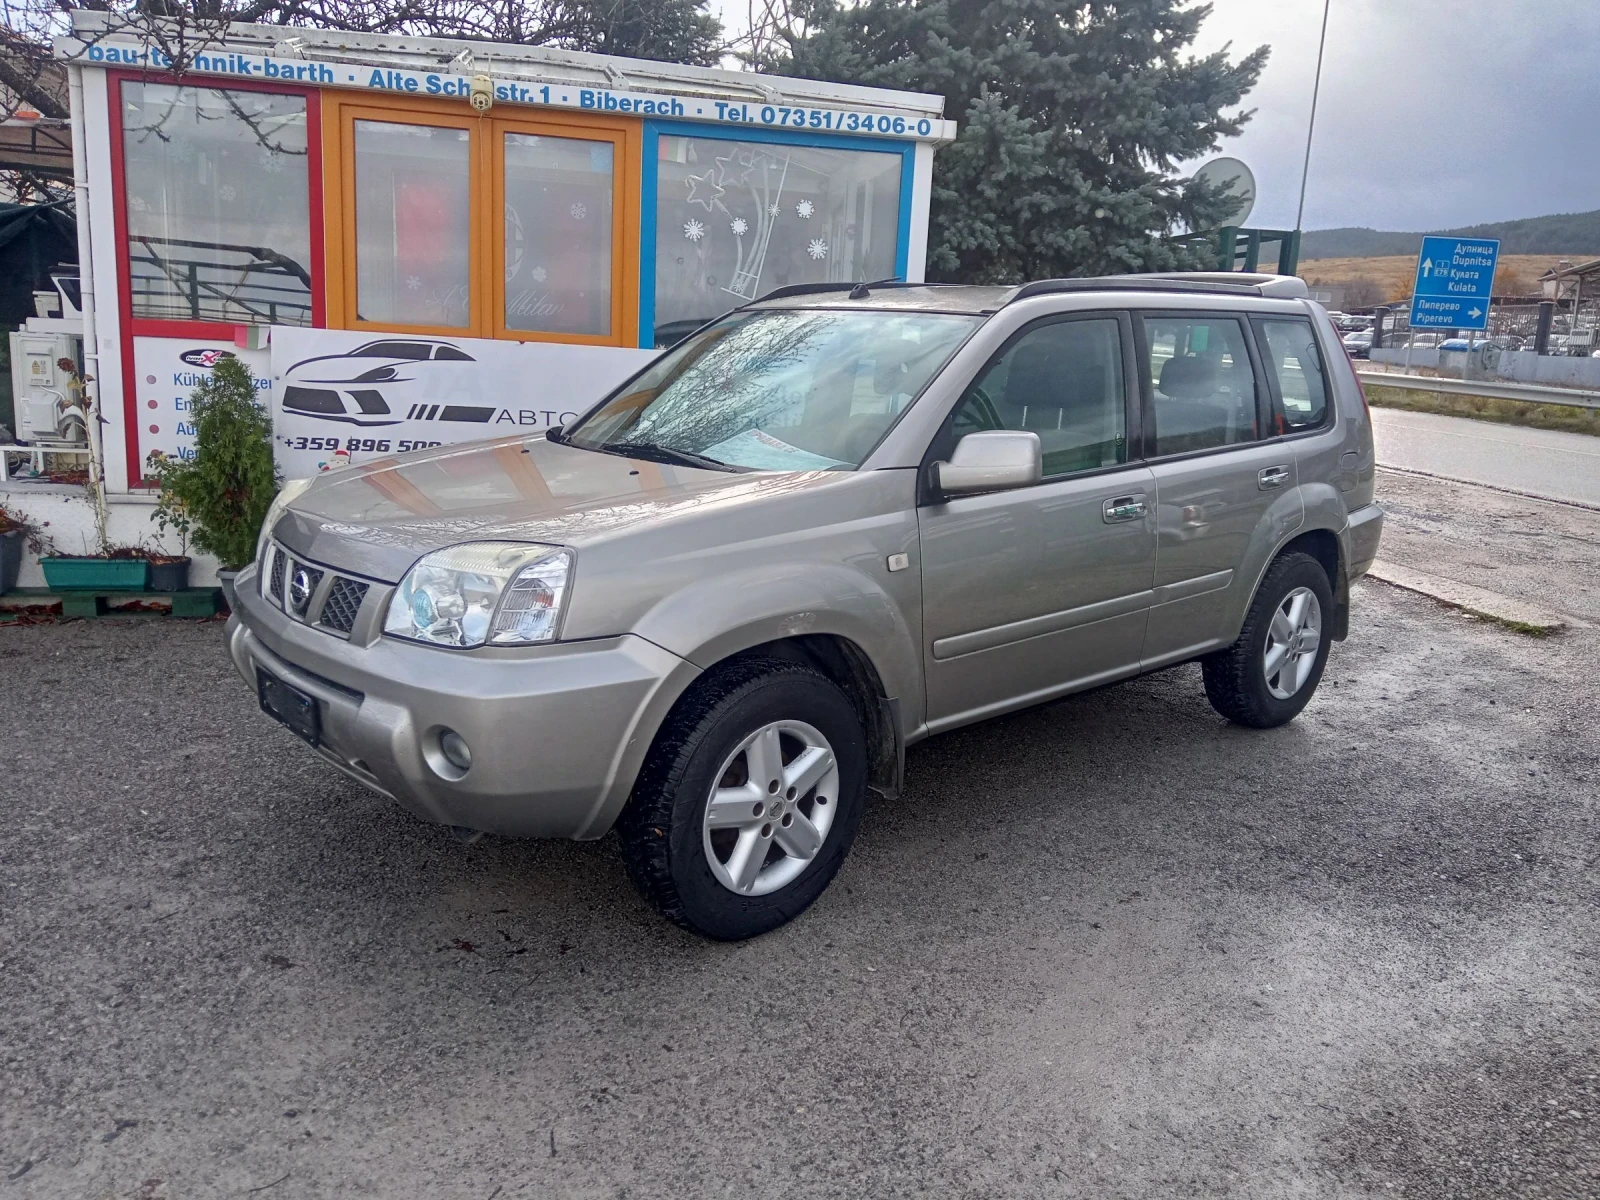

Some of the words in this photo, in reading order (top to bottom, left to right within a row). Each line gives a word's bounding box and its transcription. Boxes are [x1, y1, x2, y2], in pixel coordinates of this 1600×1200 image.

[368, 69, 418, 92] Alte
[580, 89, 684, 116] Biberach
[715, 102, 754, 122] Tel.
[761, 106, 931, 136] 07351/3406-0
[1454, 243, 1493, 255] Дупница
[1452, 255, 1492, 267] Dupnitsa
[1450, 268, 1479, 280] Кулата
[1448, 281, 1477, 292] Kulata
[1418, 299, 1460, 311] Пиперево
[1416, 312, 1453, 324] Piperevo
[284, 436, 340, 451] +359
[346, 438, 391, 452] 896
